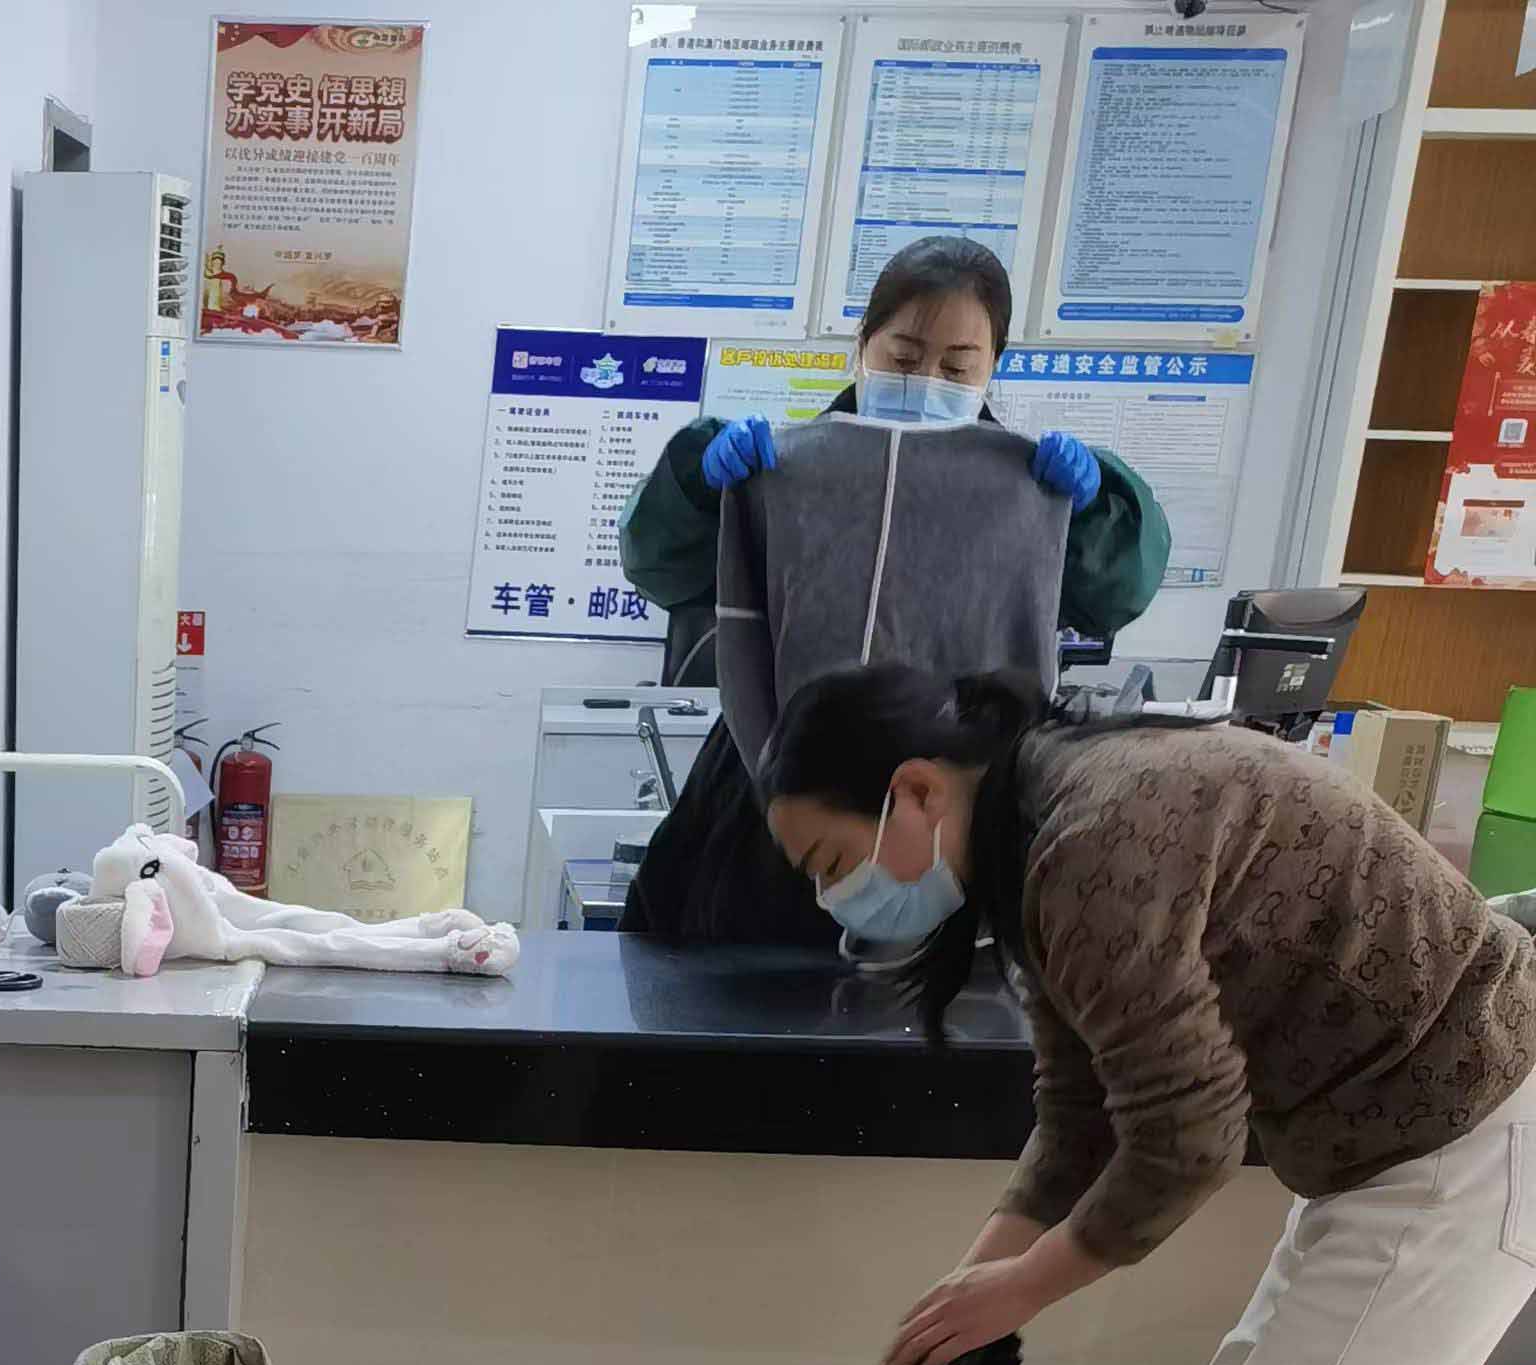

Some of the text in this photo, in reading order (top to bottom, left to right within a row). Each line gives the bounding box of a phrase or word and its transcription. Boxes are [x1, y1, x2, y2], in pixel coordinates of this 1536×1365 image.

[226, 72, 407, 109] 学党史 悟思想
[225, 104, 405, 144] 办实事 开新局
[995, 352, 1209, 376] 点寄递安全监管公示
